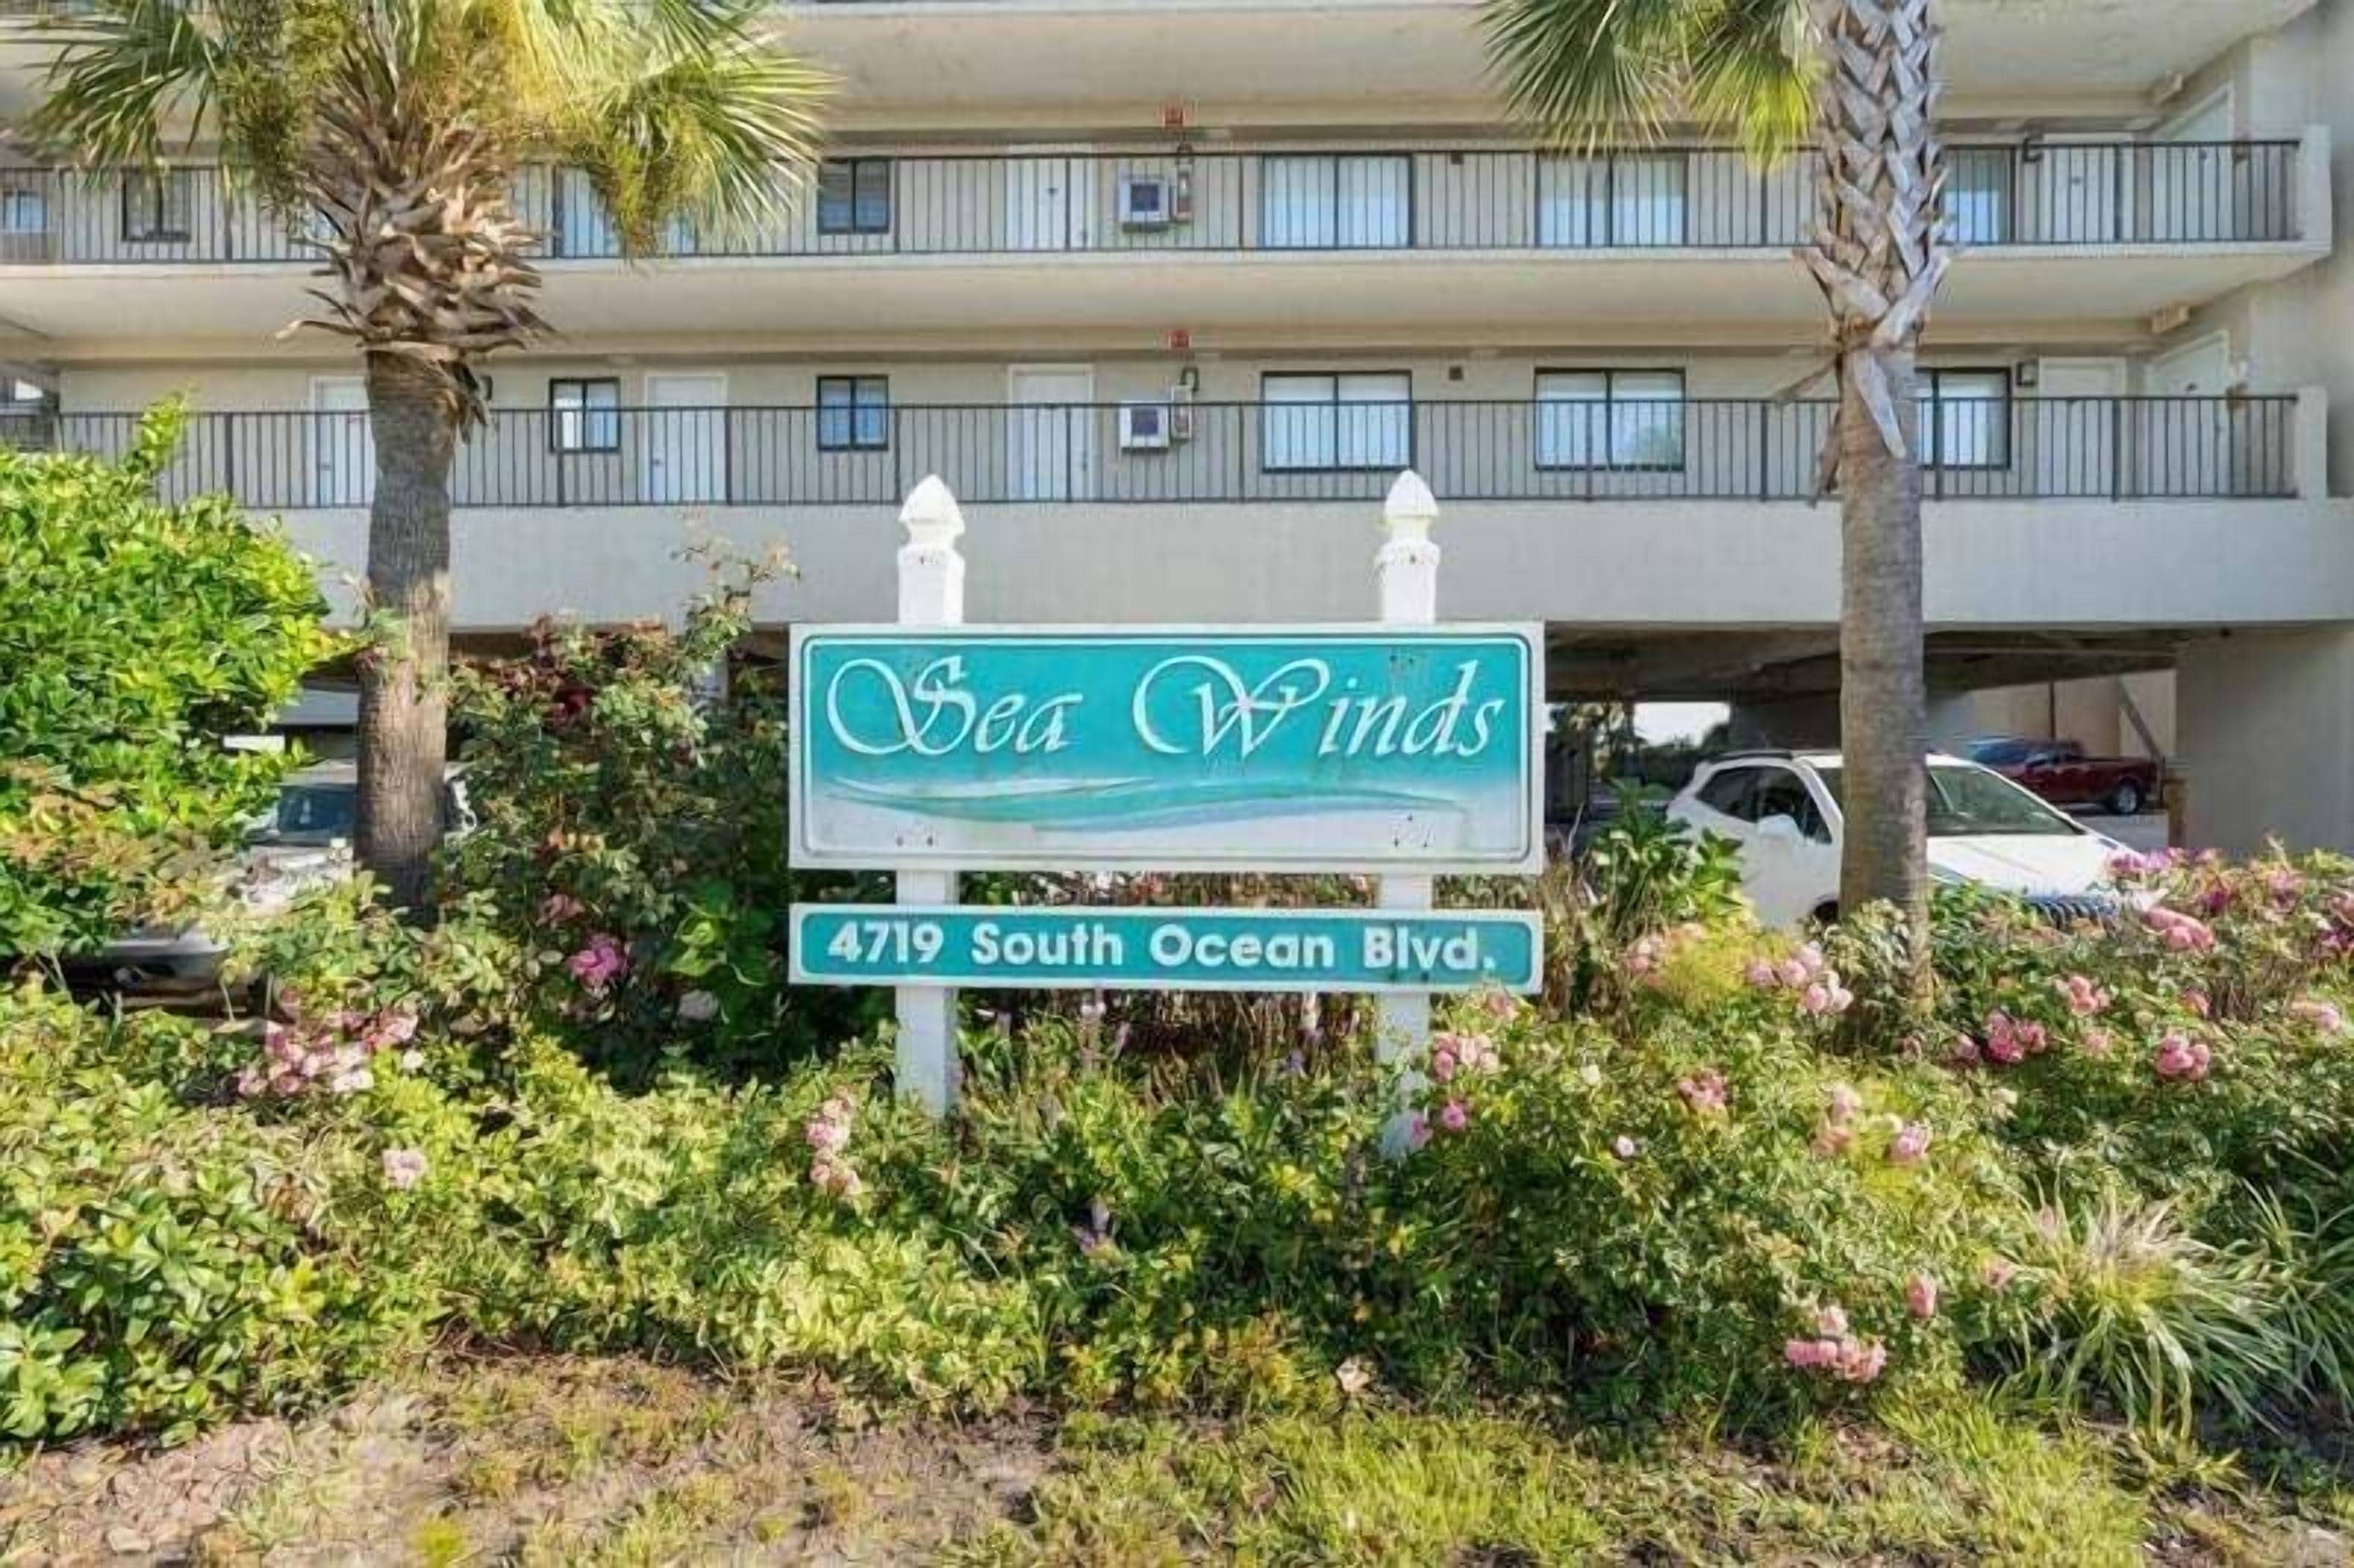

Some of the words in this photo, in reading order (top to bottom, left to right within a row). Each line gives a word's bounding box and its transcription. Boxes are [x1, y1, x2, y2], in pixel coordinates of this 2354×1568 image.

[825, 654, 1084, 756] Sea
[1131, 654, 1505, 759] Winds
[828, 921, 944, 964] 4719
[971, 923, 1123, 966] South
[1150, 924, 1335, 968] Ocean
[1364, 924, 1497, 970] Blvd.
